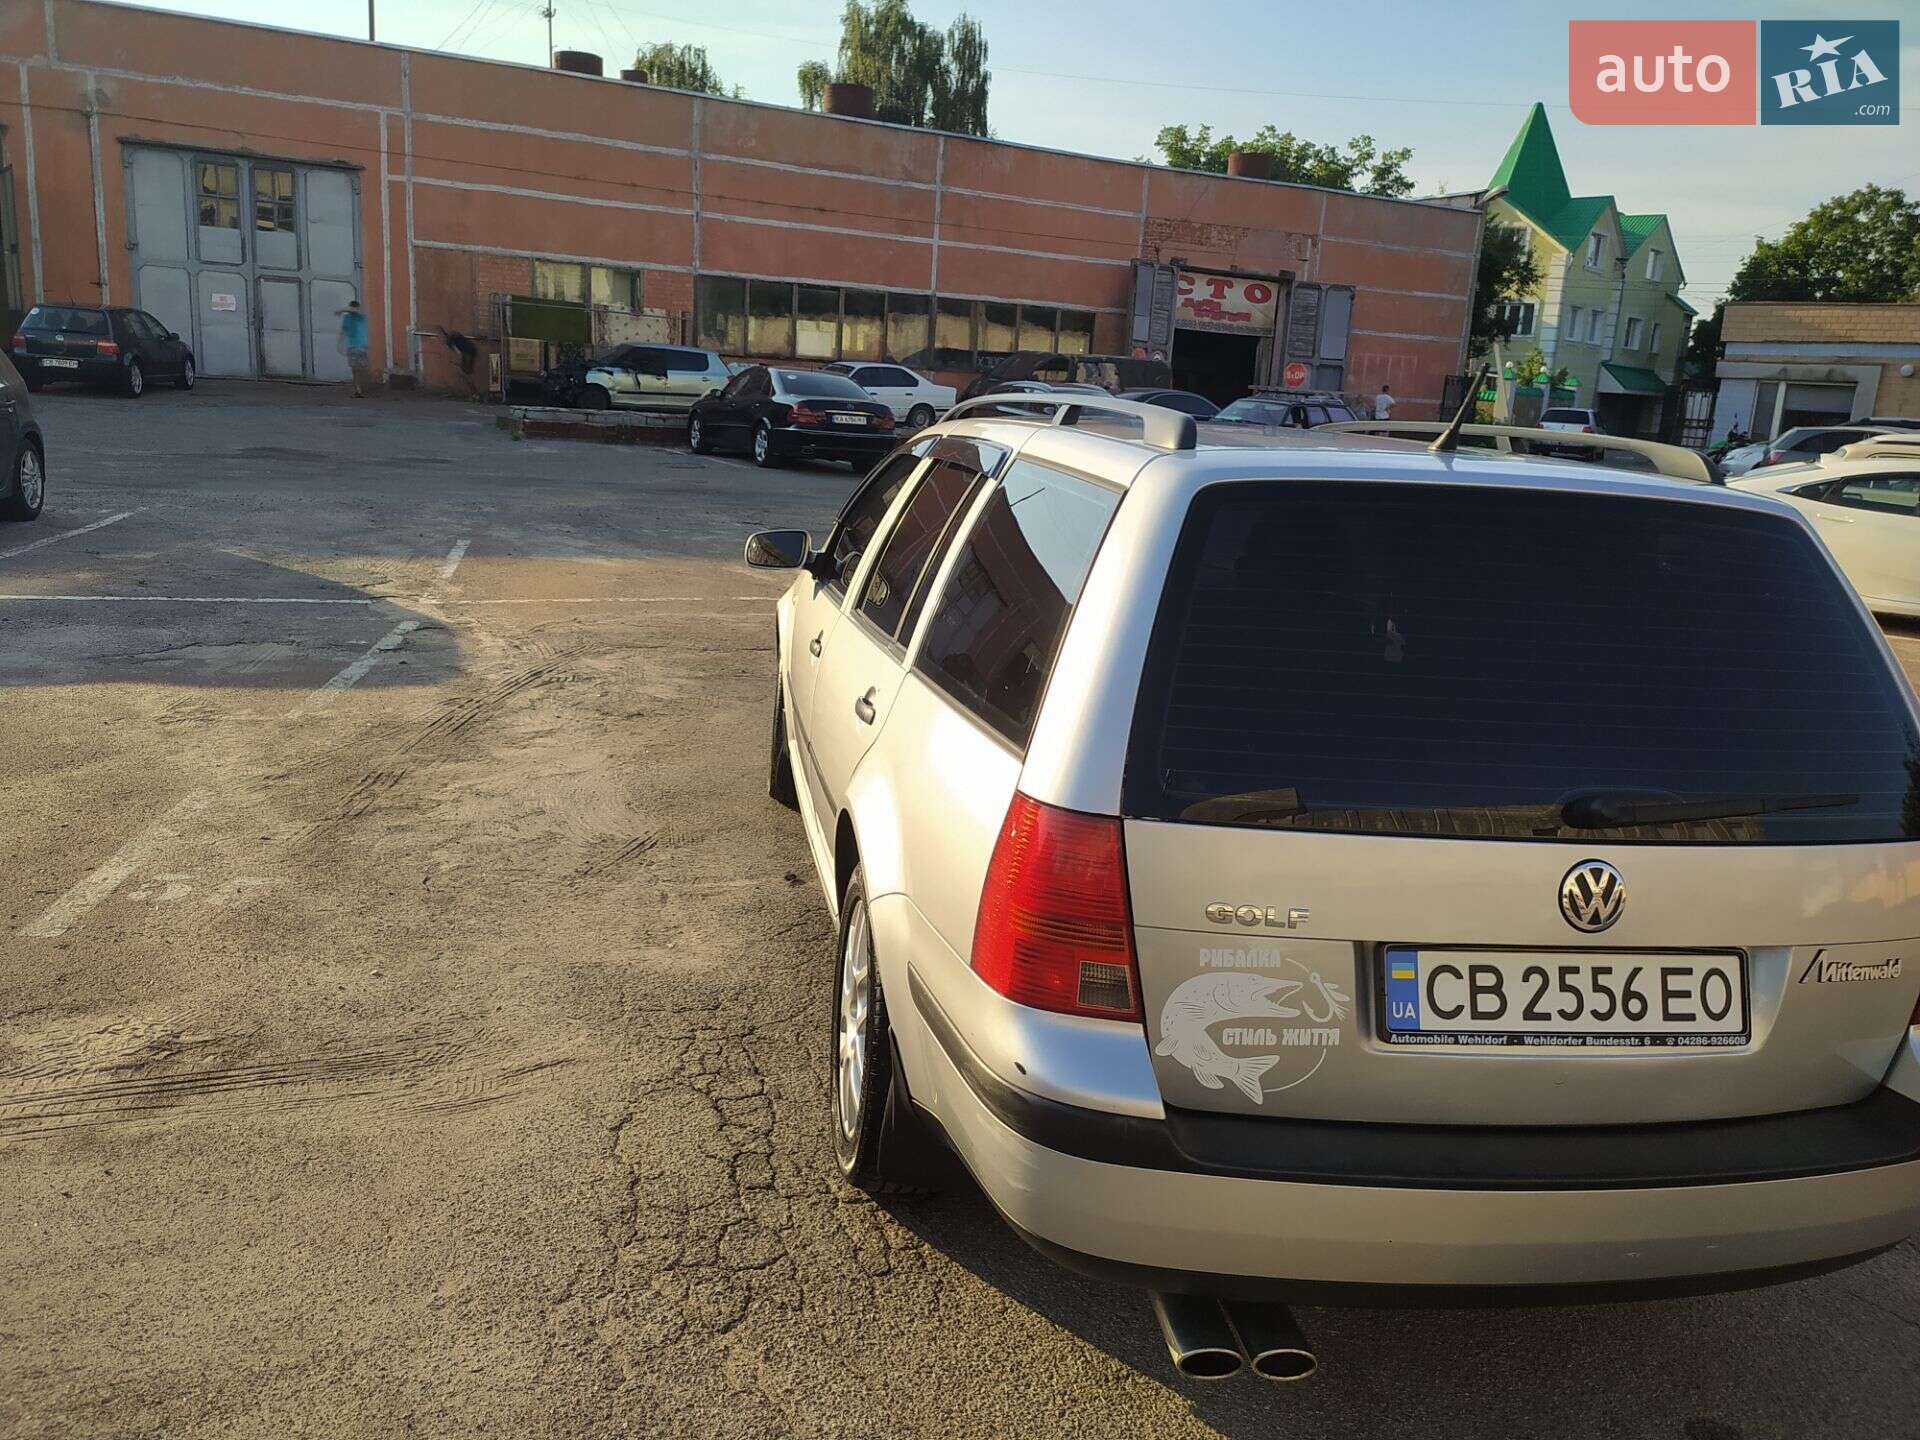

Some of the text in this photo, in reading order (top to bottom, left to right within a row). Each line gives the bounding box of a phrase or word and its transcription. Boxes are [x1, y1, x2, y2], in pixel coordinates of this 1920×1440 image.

[1177, 274, 1272, 304] СТО
[1205, 902, 1312, 929] GOLF
[1199, 948, 1281, 968] РИБАЛКА
[1426, 964, 1733, 1022] CB 2556 EO
[1391, 1002, 1416, 1019] UA
[1222, 1028, 1340, 1046] СТИЛЬ ЖИТТЯ
[1390, 1034, 1455, 1044] Automobile
[1458, 1034, 1508, 1045] Wehldorf
[1523, 1035, 1583, 1046] Wehldorfer
[1585, 1036, 1642, 1046] Bundesstr.
